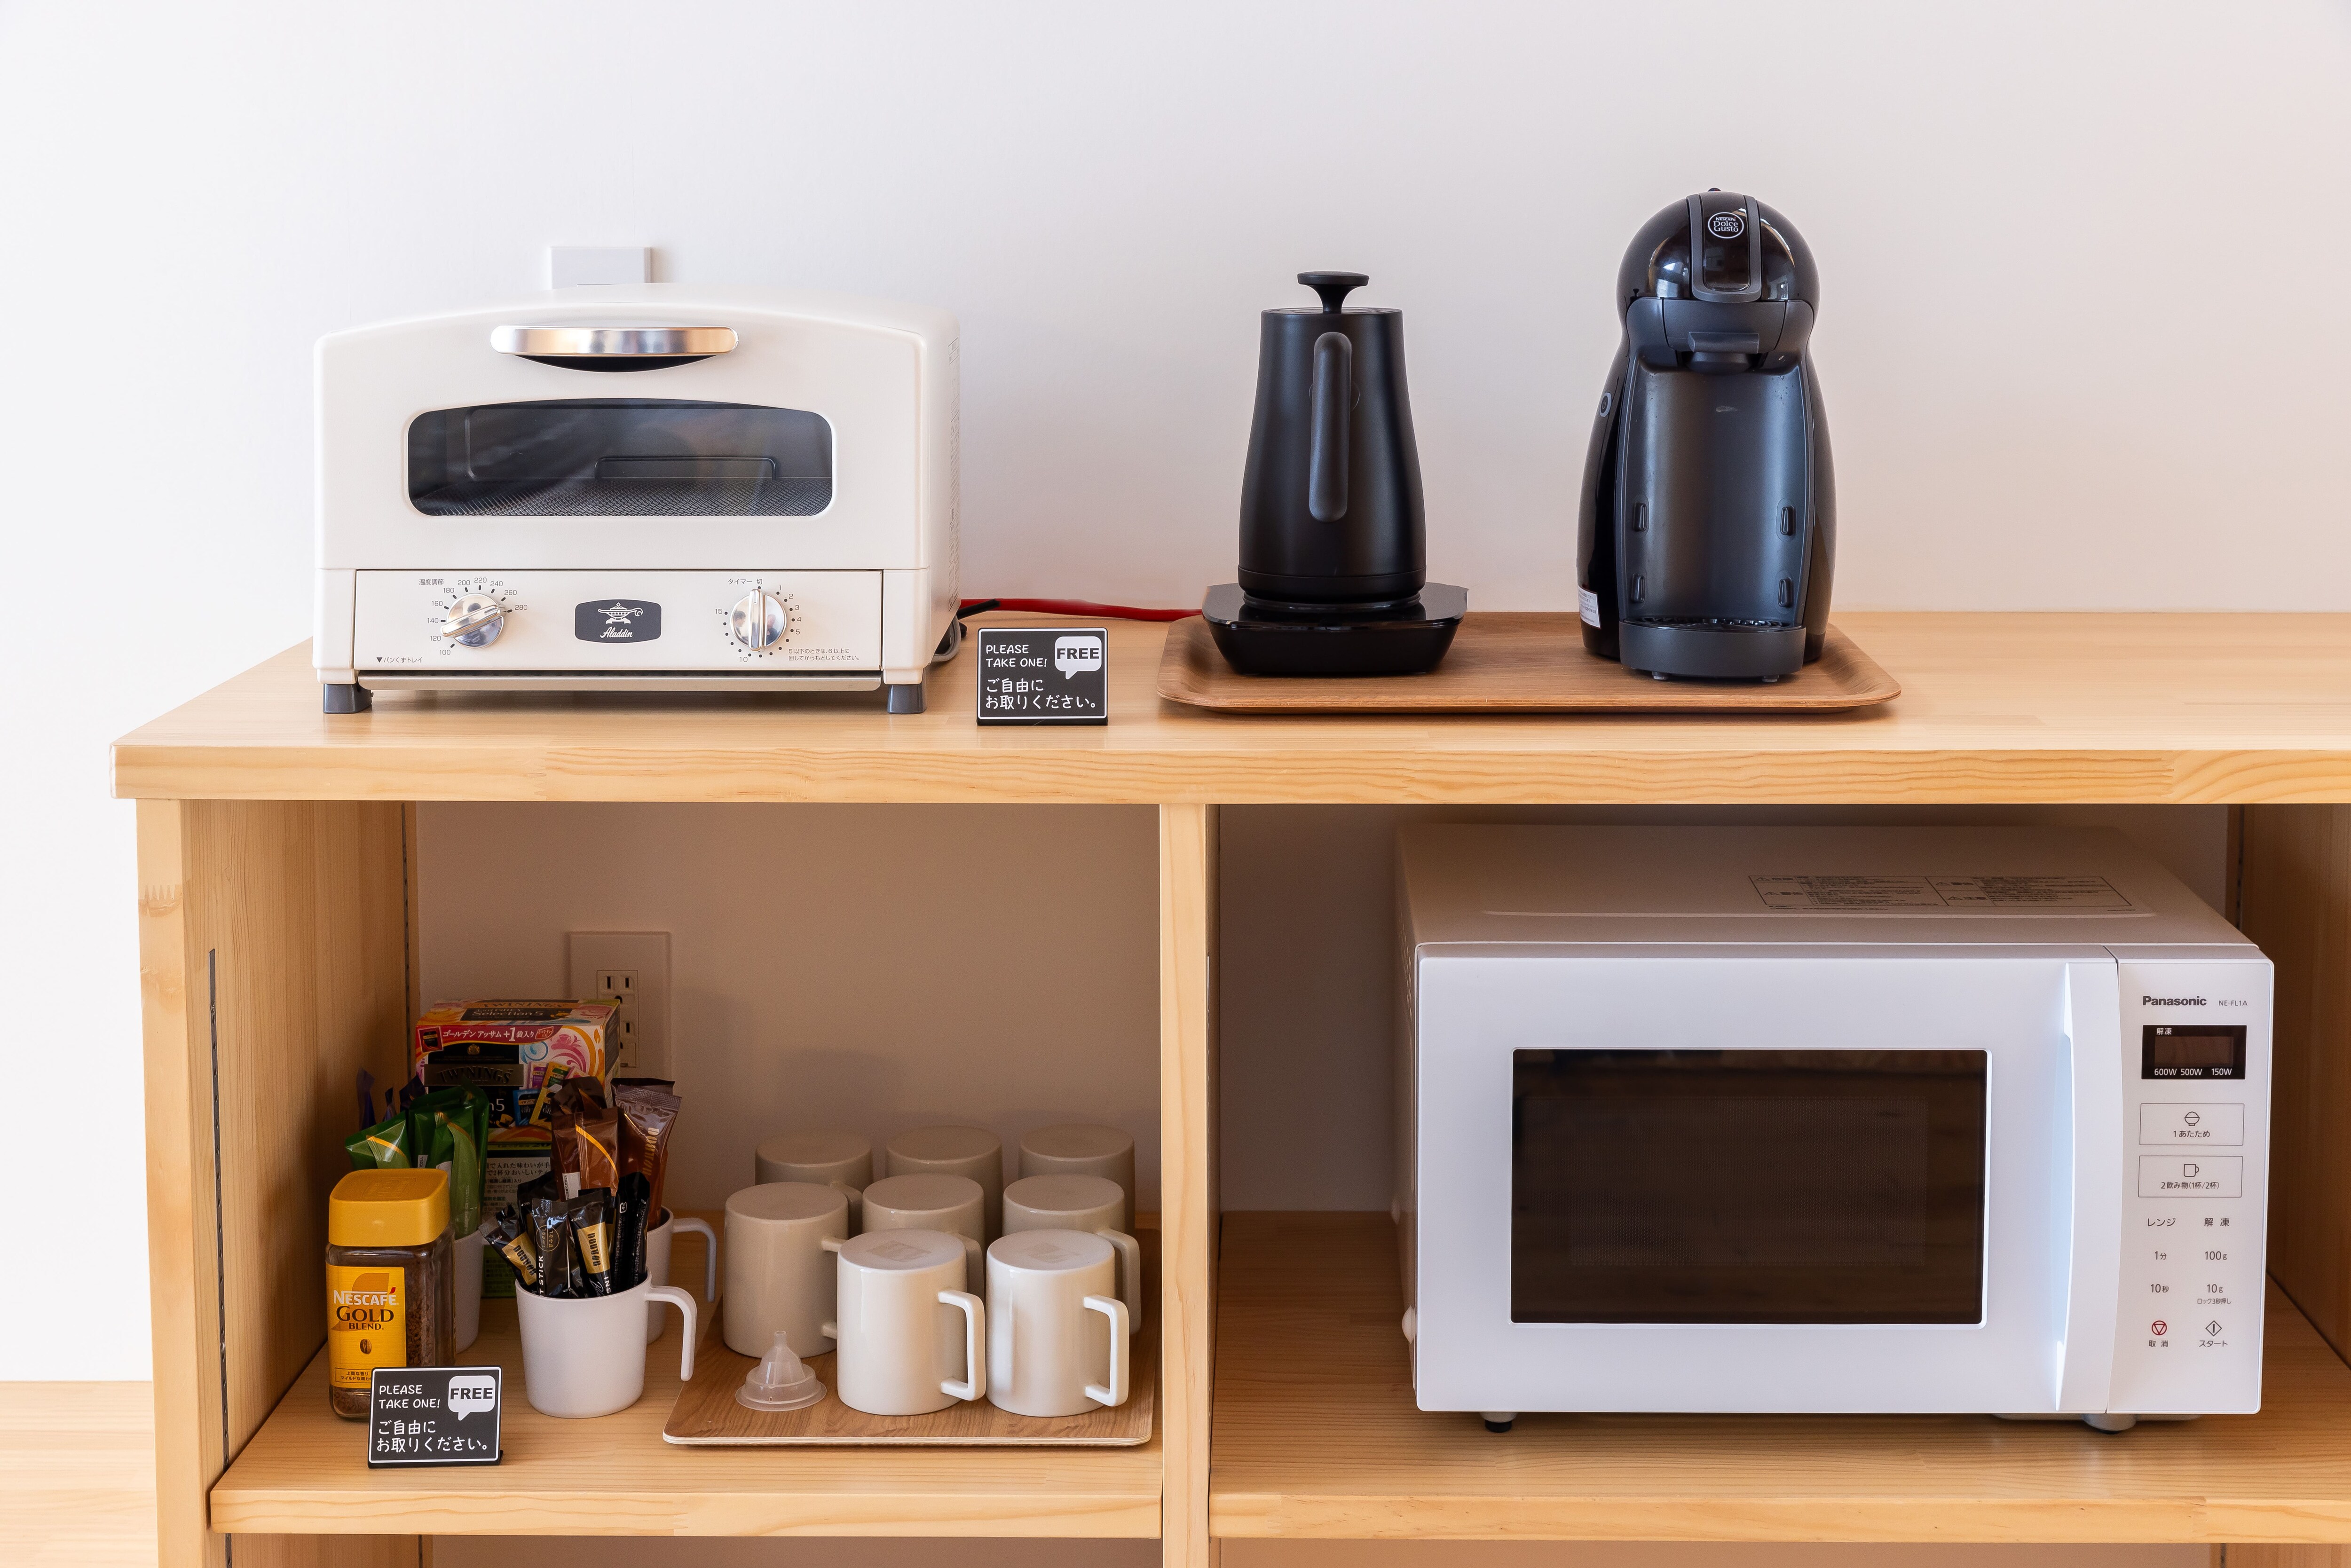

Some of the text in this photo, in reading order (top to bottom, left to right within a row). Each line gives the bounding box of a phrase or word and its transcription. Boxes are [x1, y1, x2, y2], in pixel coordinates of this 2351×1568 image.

[600, 626, 633, 640] Aladdin
[986, 644, 1029, 654] PLEASE
[1057, 648, 1099, 660] FREE
[986, 658, 1047, 668] TAKE ONE!
[986, 678, 1044, 693] ご自由に
[986, 694, 1096, 710] お取りください。
[2143, 995, 2207, 1006] Panasonic
[442, 1029, 476, 1039] ゴールデン
[477, 1030, 502, 1039] アッサム
[641, 1127, 659, 1176] DOUTOR
[2147, 1218, 2176, 1227] レンジ
[587, 1232, 601, 1267] DOUTOR
[2154, 1251, 2167, 1260] 1分
[513, 1245, 536, 1276] DOUTOR
[2204, 1251, 2227, 1261] 100g
[2150, 1284, 2169, 1293] 10秒
[2207, 1284, 2223, 1293] 10g
[333, 1287, 396, 1306] NESCAFÉ
[336, 1306, 394, 1322] GOLD
[379, 1384, 423, 1395] PLEASE
[450, 1387, 493, 1400] FREE
[378, 1398, 441, 1409] TAKE ONE!
[379, 1419, 436, 1435] ご自由に
[377, 1436, 487, 1453] お取りください。
